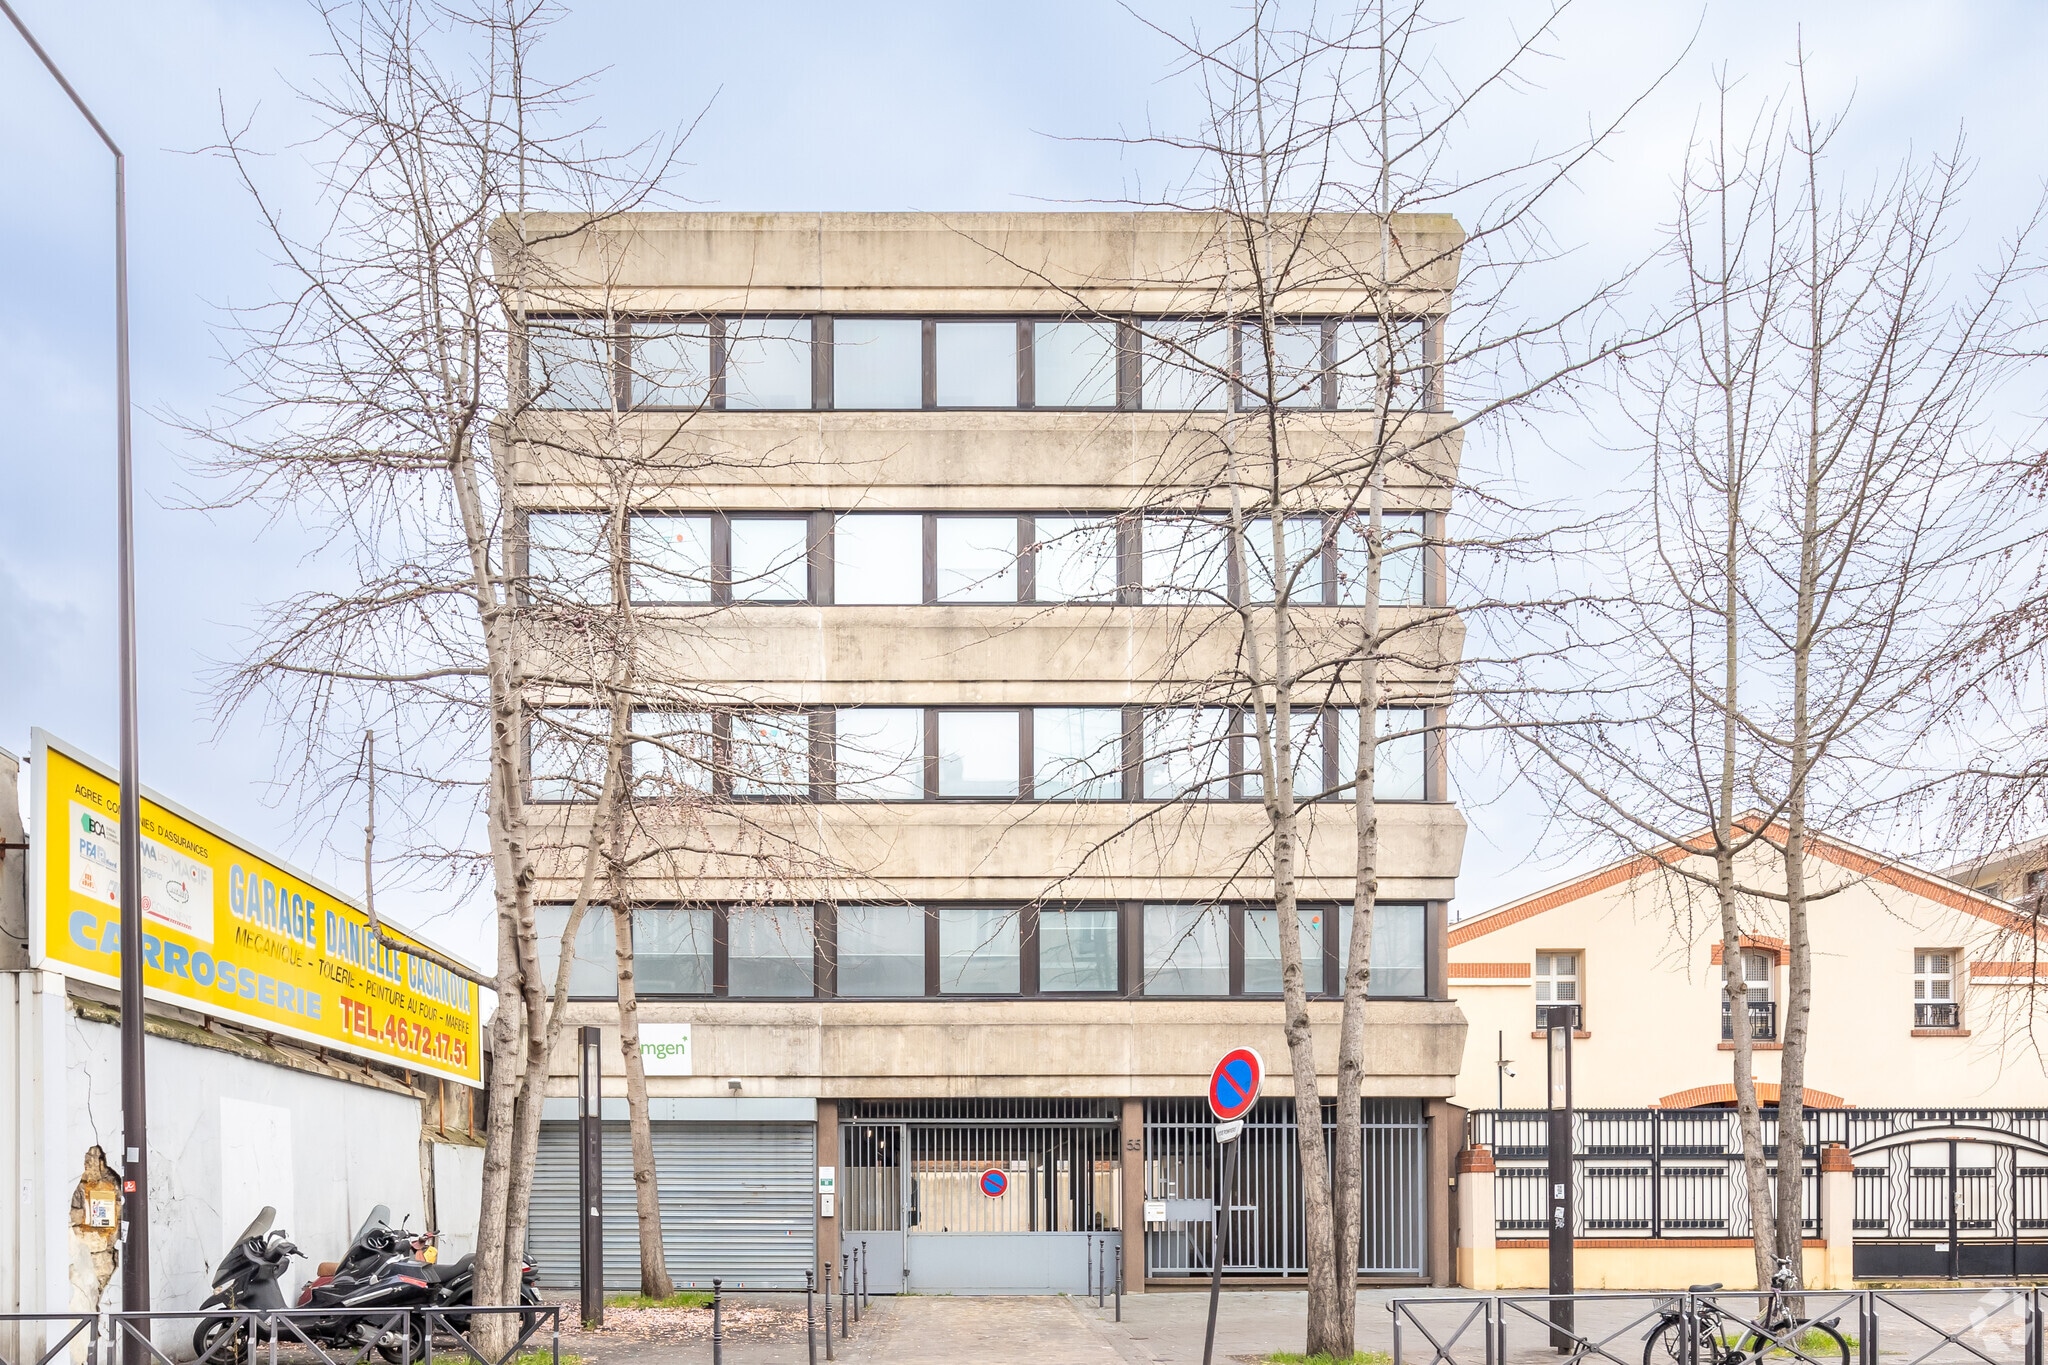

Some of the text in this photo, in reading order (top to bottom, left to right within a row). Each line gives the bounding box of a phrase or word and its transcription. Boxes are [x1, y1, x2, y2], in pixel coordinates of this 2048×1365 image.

[75, 783, 103, 807] AGREE
[157, 825, 209, 859] D'ASSURANCES
[88, 817, 106, 839] BCA
[79, 837, 97, 860] PFA
[171, 854, 207, 887] MACIF
[68, 910, 321, 1020] CARROSSERIE
[230, 864, 470, 1015] GARAGE DANIELLE CASANOVA
[235, 926, 303, 968] MECANIQUE
[318, 958, 355, 989] TOLERIE
[366, 979, 405, 1009] PEINTURE
[407, 997, 417, 1015] AU
[420, 1002, 438, 1021] FOUR
[640, 1043, 685, 1060] mgen
